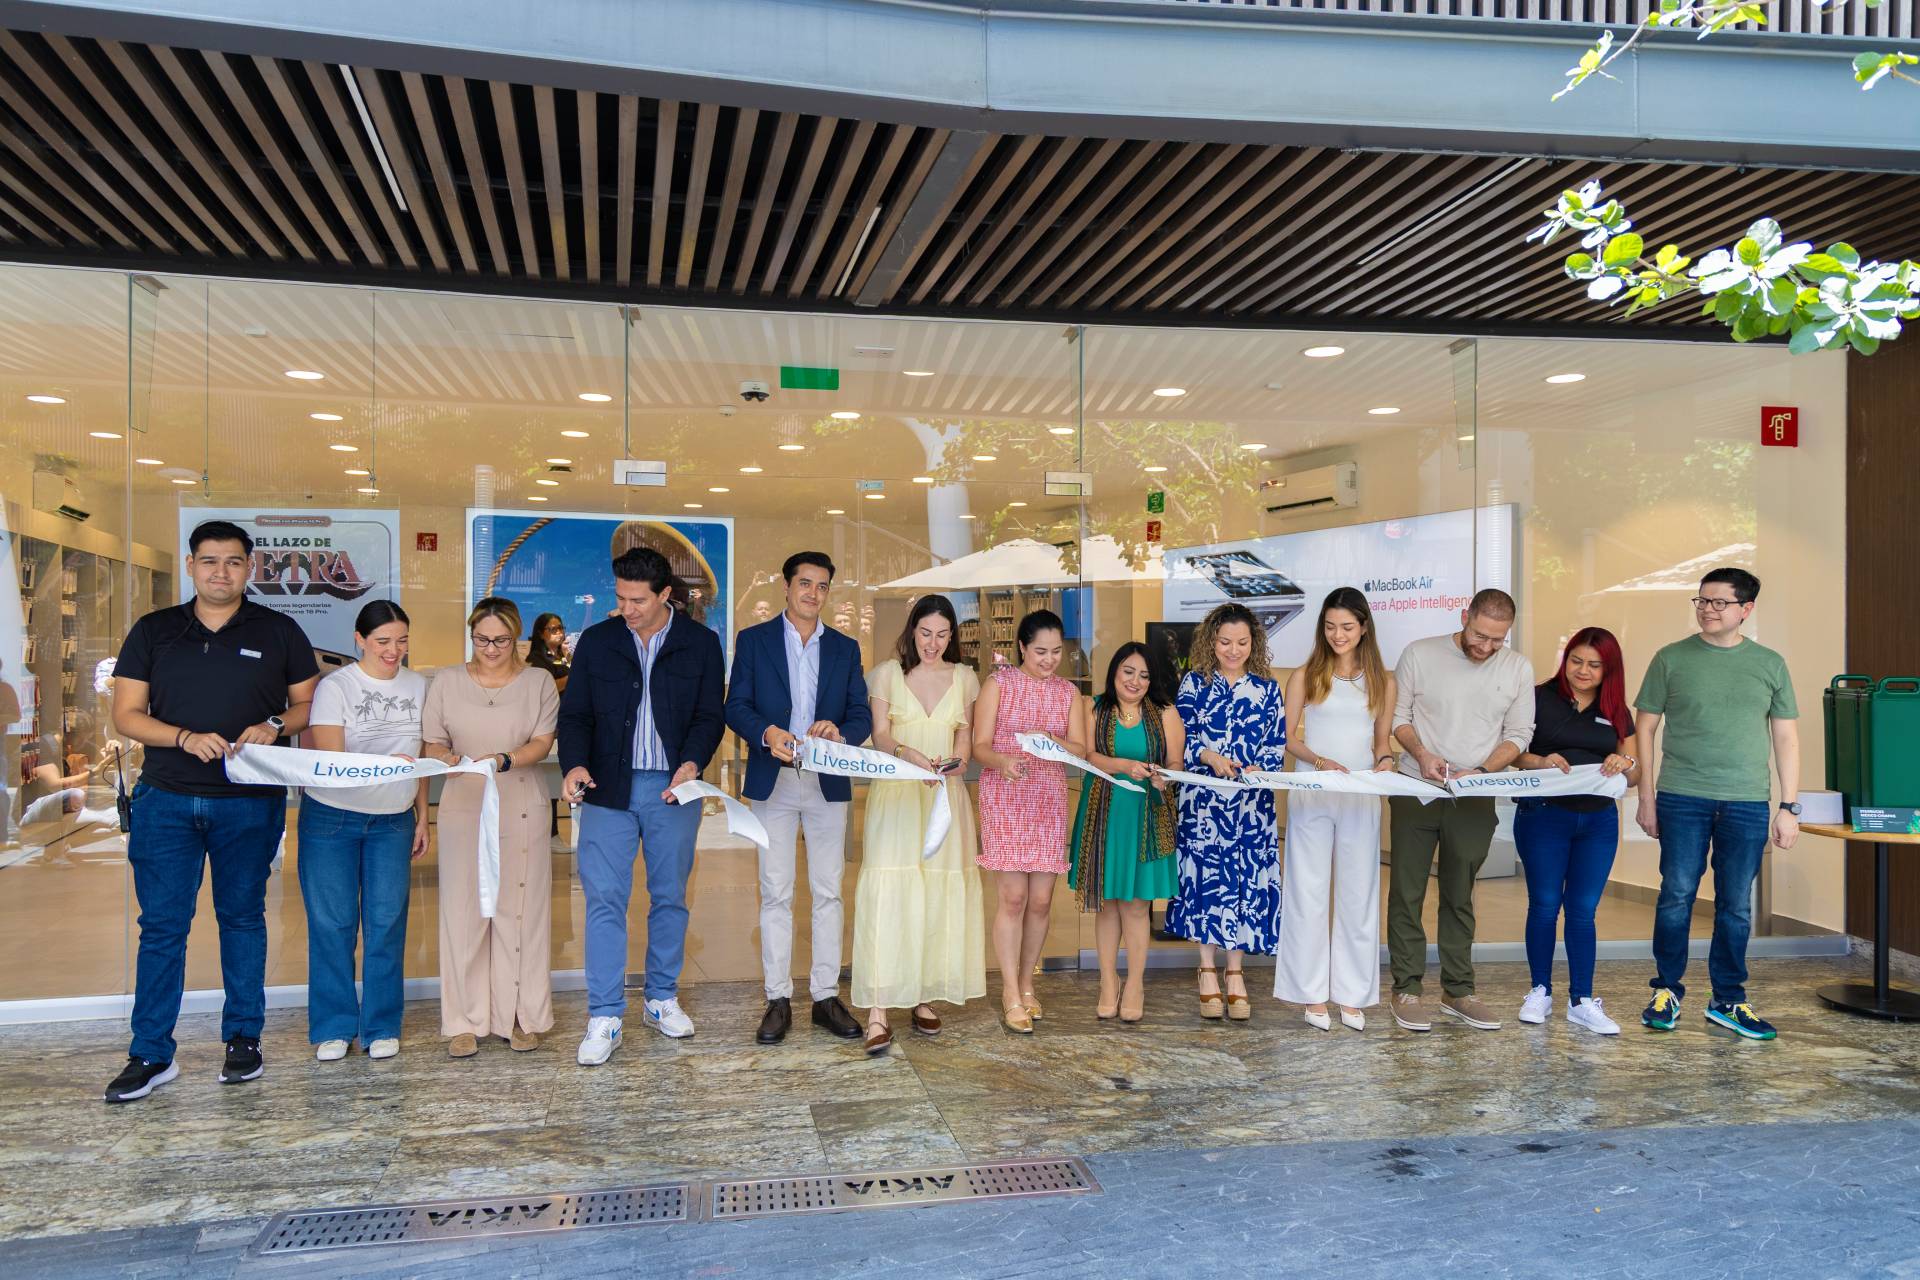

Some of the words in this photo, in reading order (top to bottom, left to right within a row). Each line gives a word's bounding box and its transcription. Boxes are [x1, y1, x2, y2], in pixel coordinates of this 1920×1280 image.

[255, 537, 270, 547] EL
[274, 537, 310, 548] LAZO
[314, 538, 332, 548] DE
[247, 550, 375, 593] ETRA
[1371, 579, 1417, 592] MacBook
[1419, 576, 1433, 589] Air
[1388, 597, 1417, 613] Apple
[314, 761, 415, 778] Livestore
[813, 748, 896, 774] Livestore
[1456, 775, 1541, 789] Livestore
[843, 1174, 955, 1195] AKIA
[427, 1202, 552, 1227] AKIA
